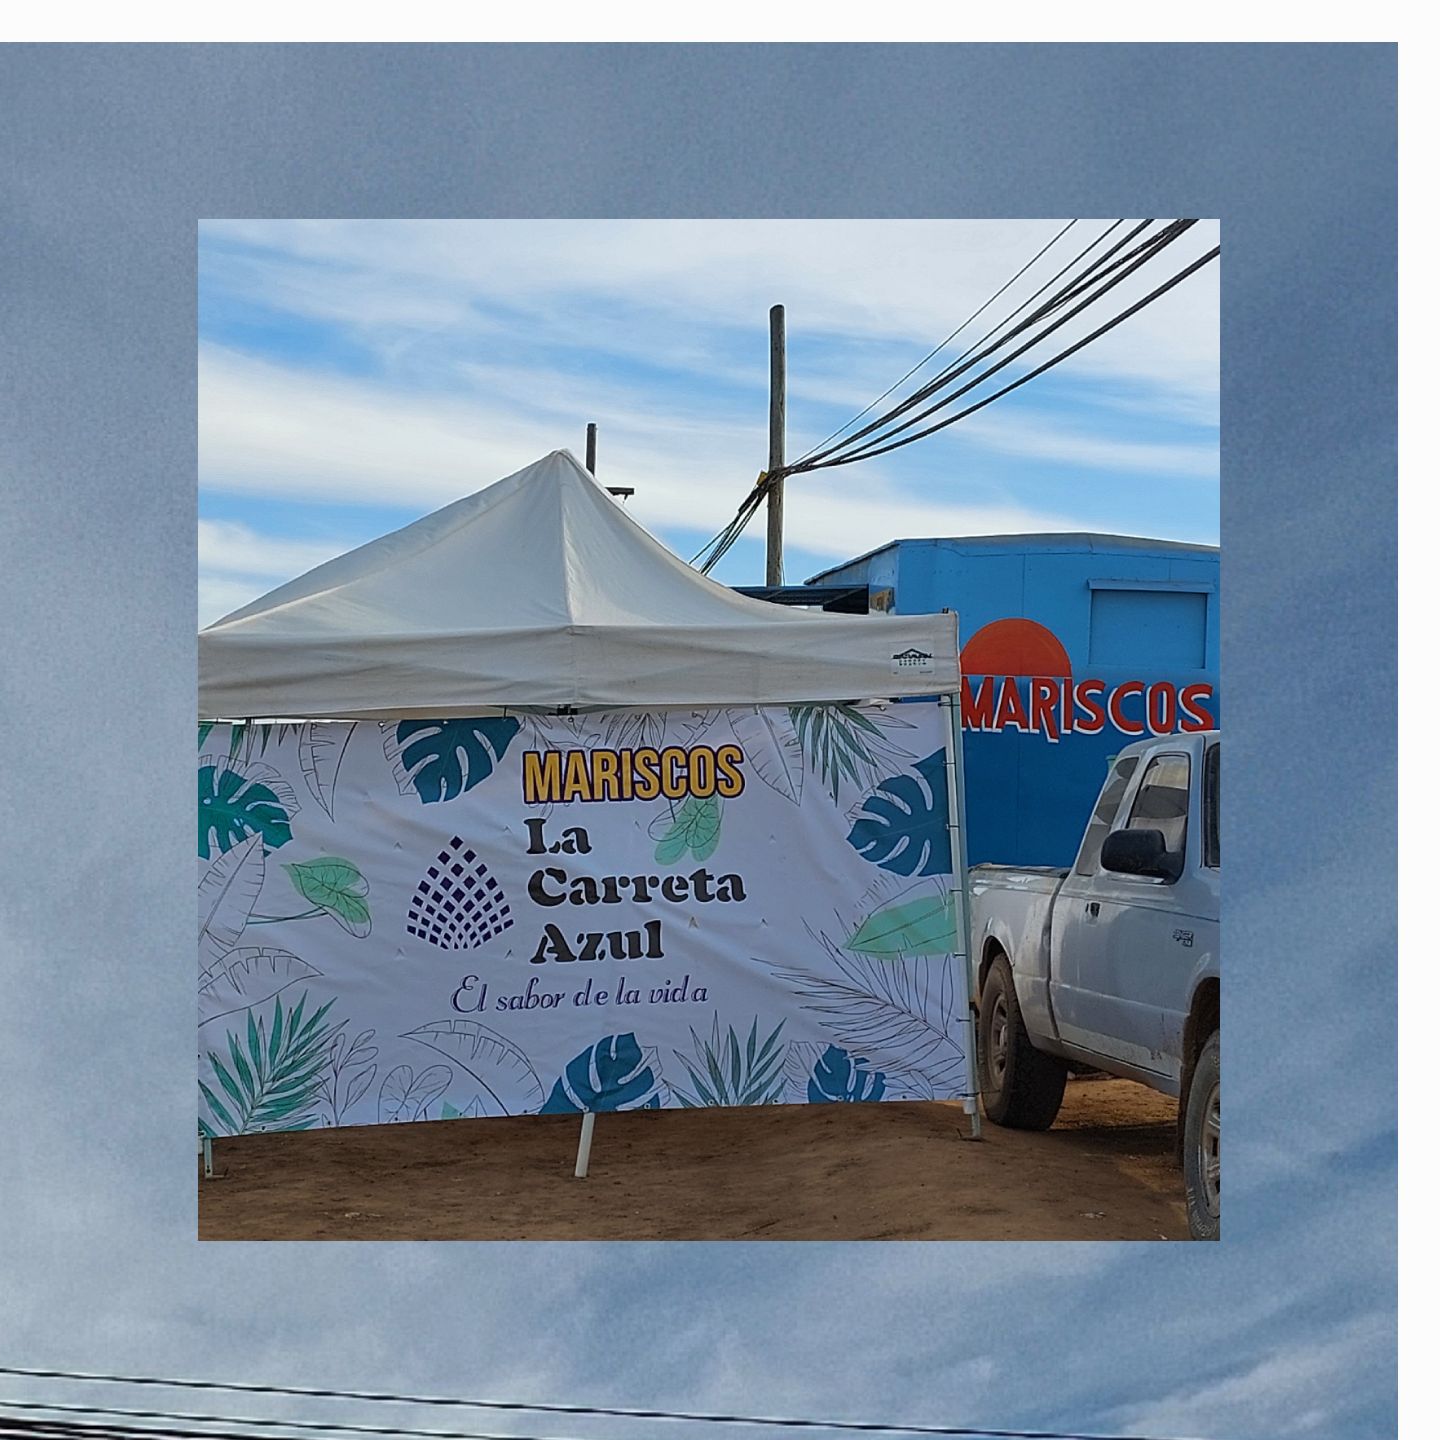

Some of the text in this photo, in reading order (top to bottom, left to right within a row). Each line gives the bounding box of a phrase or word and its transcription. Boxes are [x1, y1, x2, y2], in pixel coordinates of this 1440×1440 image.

[961, 675, 1214, 743] MARISCOS
[522, 744, 747, 804] MARISCOS
[523, 817, 593, 856] La
[527, 866, 748, 907] Carreta
[529, 919, 665, 964] Azul
[450, 974, 710, 1014] El sabor de la vida
